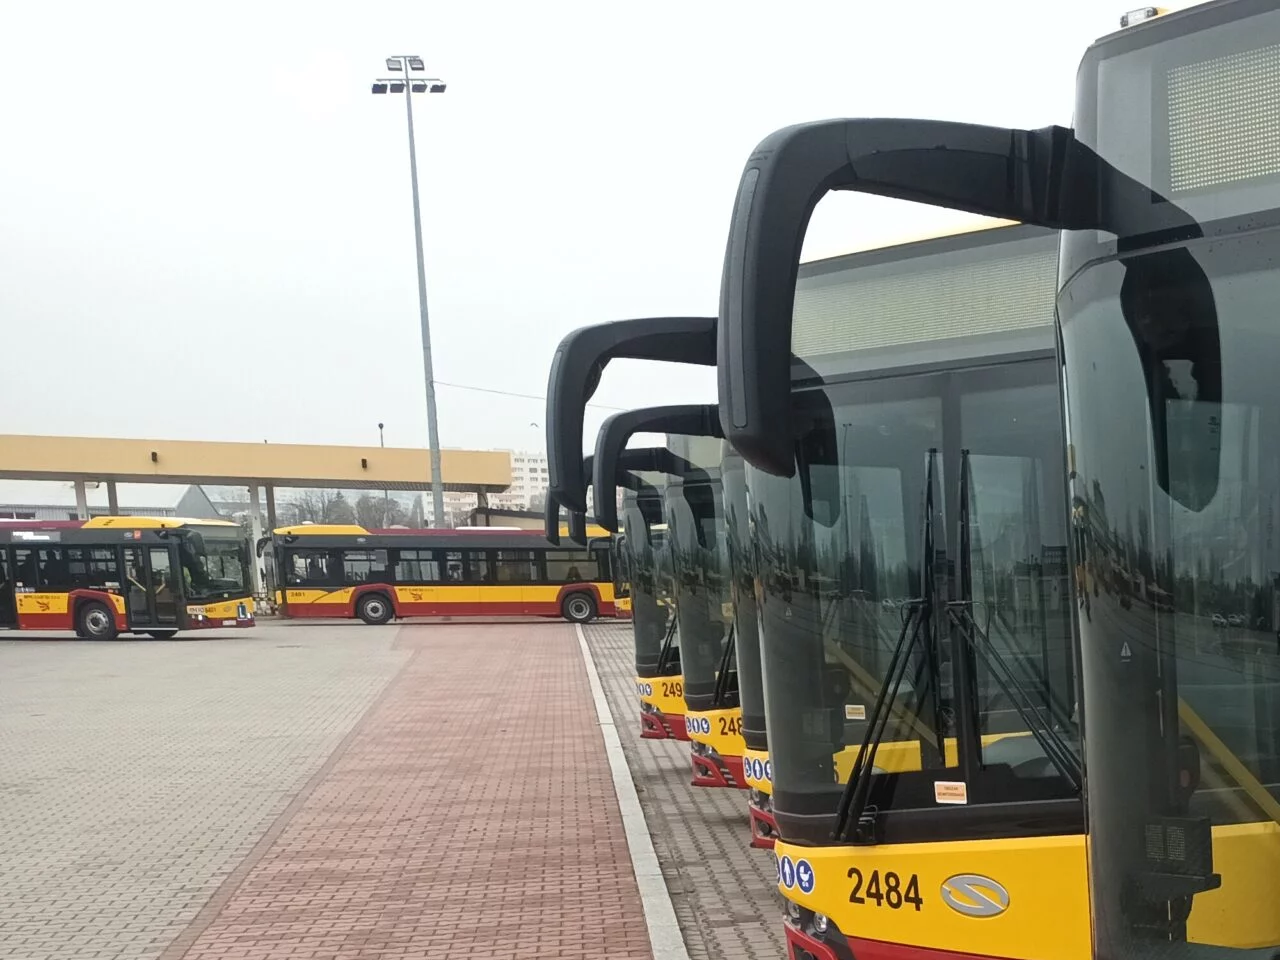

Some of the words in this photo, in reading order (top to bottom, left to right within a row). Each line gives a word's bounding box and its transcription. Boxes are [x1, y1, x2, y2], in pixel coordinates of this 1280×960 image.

[661, 682, 683, 697] 249
[719, 717, 742, 735] 248
[847, 867, 923, 911] 2484
